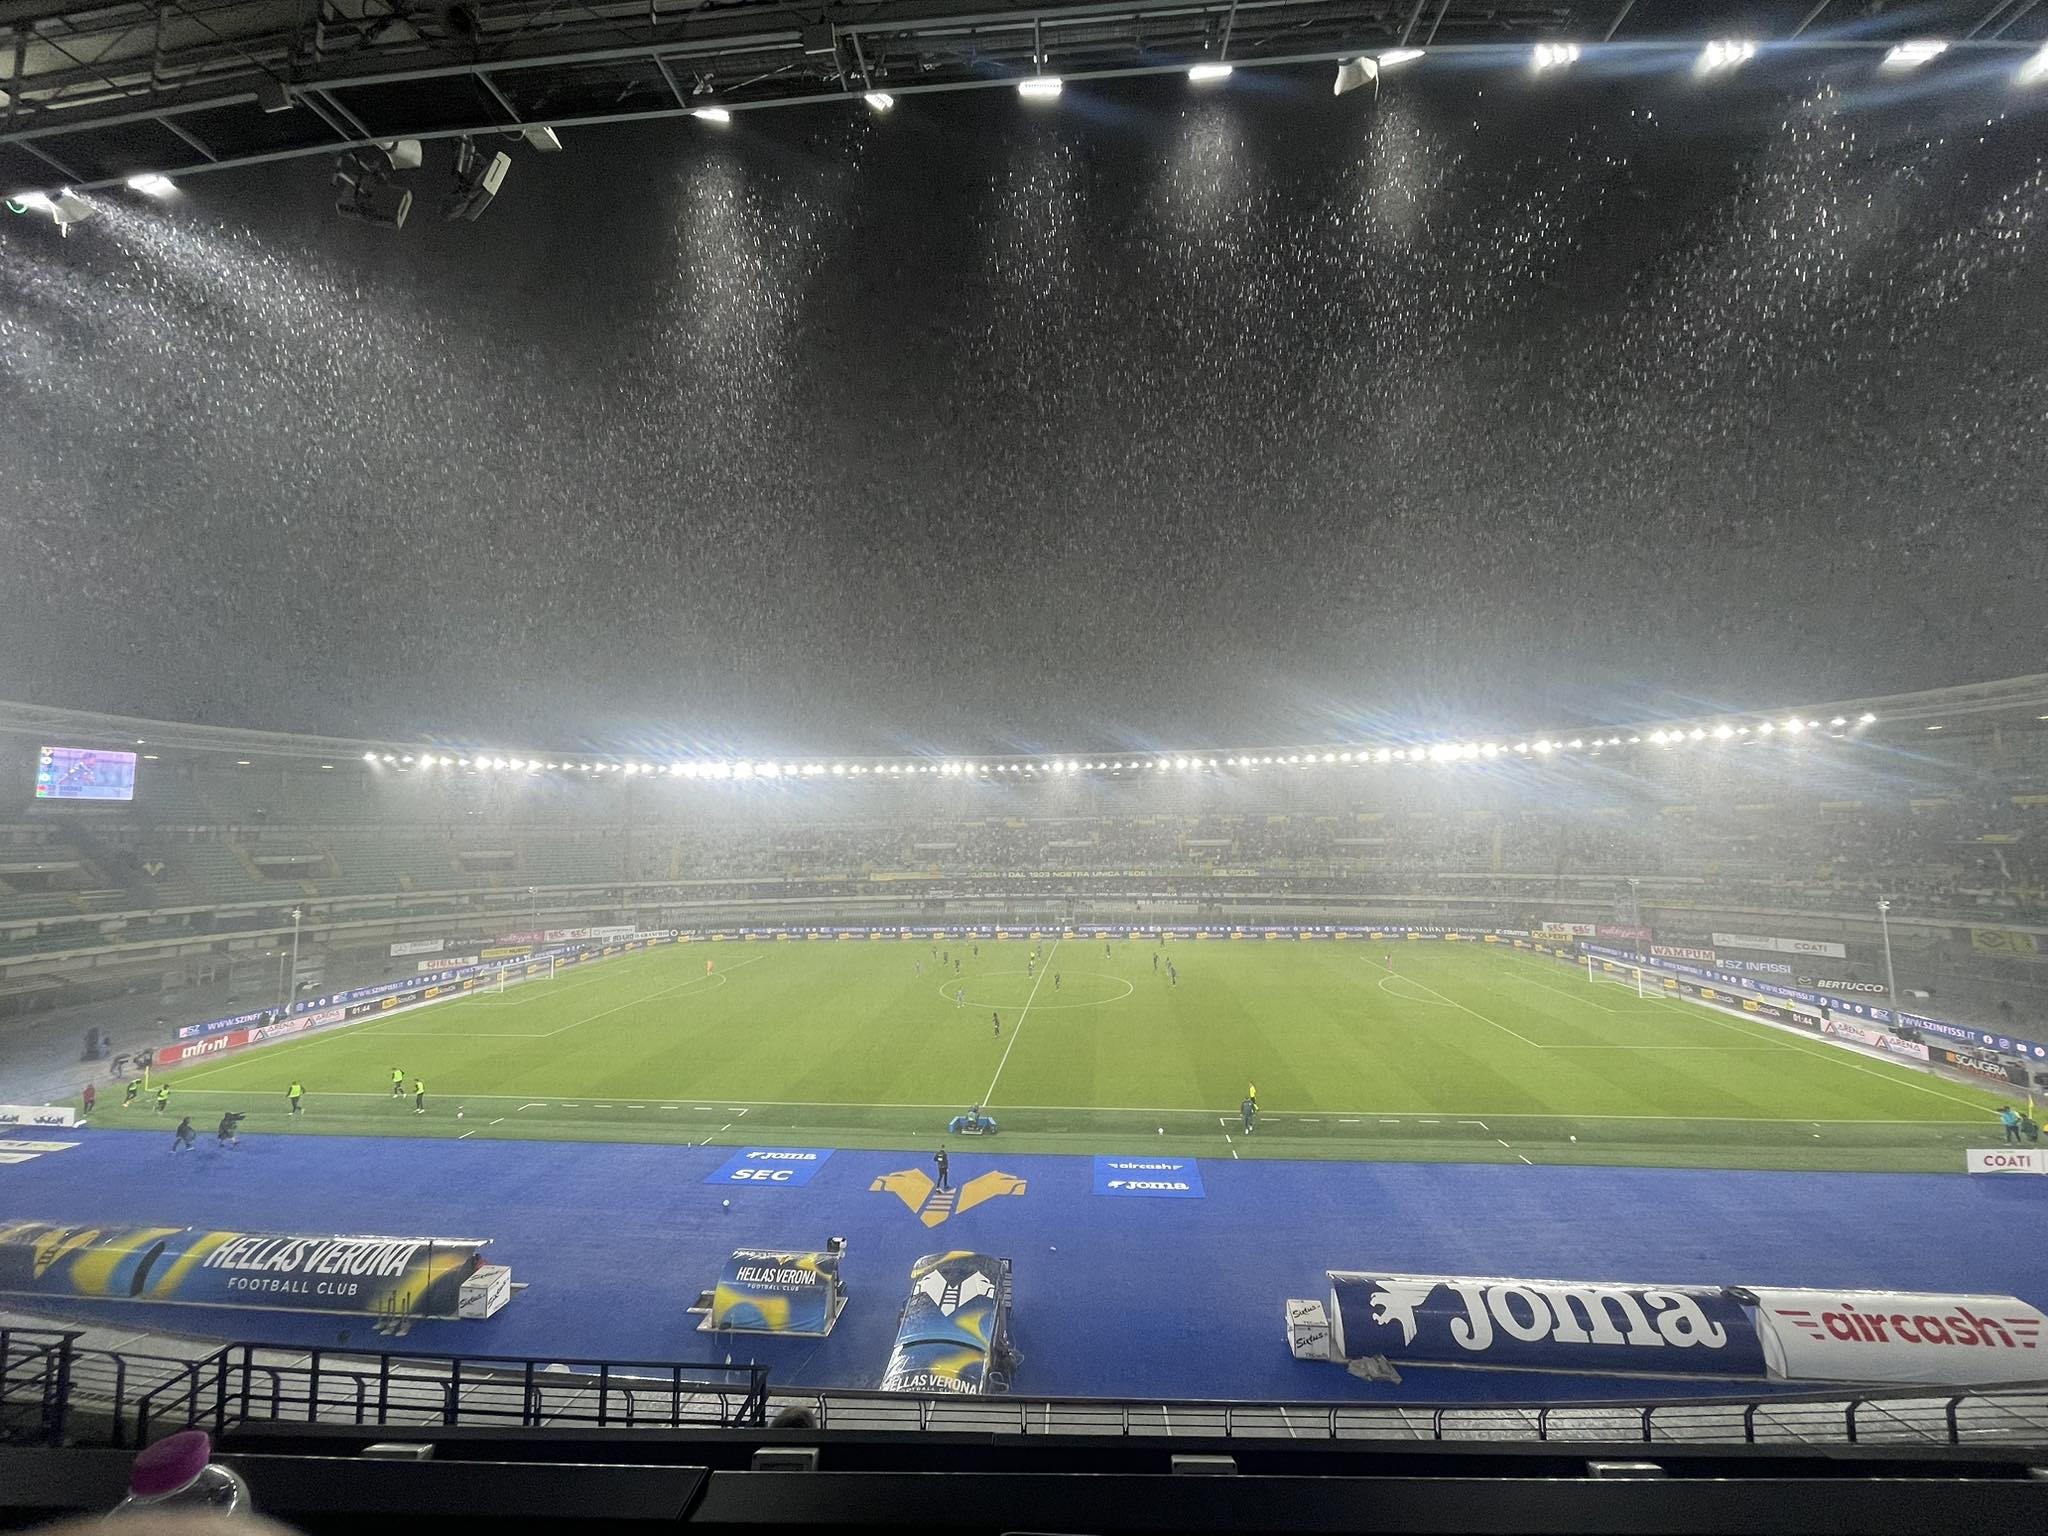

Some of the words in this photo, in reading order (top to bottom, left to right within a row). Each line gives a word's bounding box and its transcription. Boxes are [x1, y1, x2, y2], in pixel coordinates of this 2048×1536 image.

[1653, 946, 1714, 960] WAMPUM
[1793, 941, 1828, 953] COATI
[1725, 960, 1743, 969] SZ
[1745, 962, 1792, 974] INFISSI
[1817, 979, 1884, 993] BERTUCCO
[1984, 1155, 2031, 1167] COATI
[730, 1169, 794, 1181] SEC
[203, 1237, 315, 1272] HELLAS
[303, 1239, 421, 1277] VERONA
[735, 1266, 777, 1282] HELLAS
[775, 1268, 817, 1285] VERONA
[227, 1277, 309, 1294] FOOTBALL
[316, 1281, 358, 1296] CLUB
[747, 1283, 780, 1291] FOOTBALL
[1821, 1303, 2016, 1348] aircash
[929, 1374, 977, 1395] VERONA
